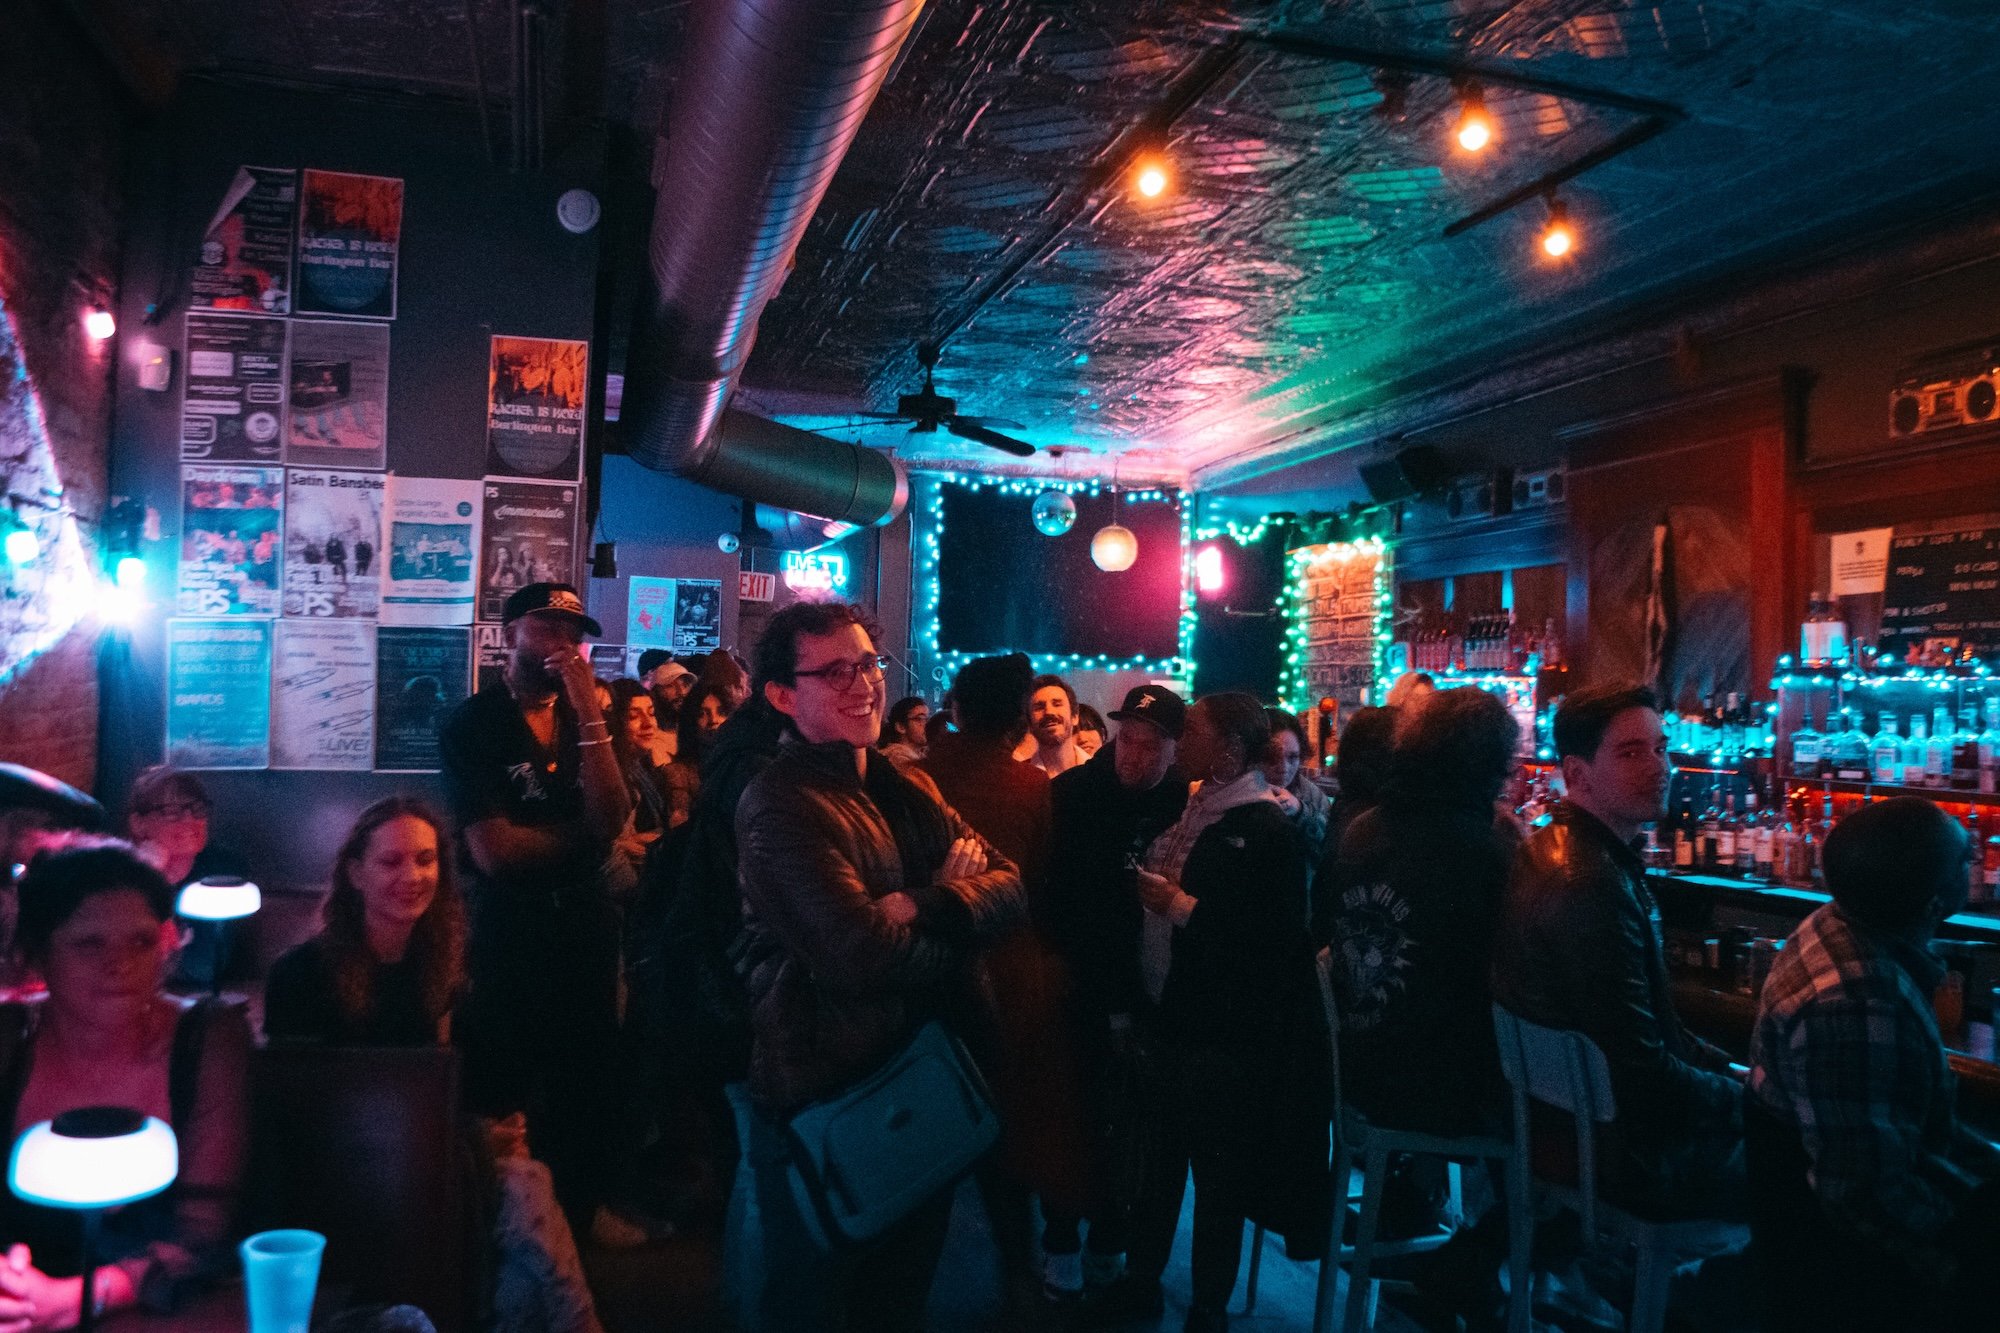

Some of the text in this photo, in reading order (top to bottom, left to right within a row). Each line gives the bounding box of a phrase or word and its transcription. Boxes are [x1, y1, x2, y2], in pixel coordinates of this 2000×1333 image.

[537, 406, 550, 417] IS
[557, 424, 579, 435] Bar
[290, 473, 325, 487] Satin
[493, 504, 566, 520] Immaculate
[787, 553, 817, 571] LIVE
[739, 573, 770, 600] EXIT
[199, 589, 230, 614] PS
[302, 592, 335, 617] PS
[683, 633, 698, 647] PS
